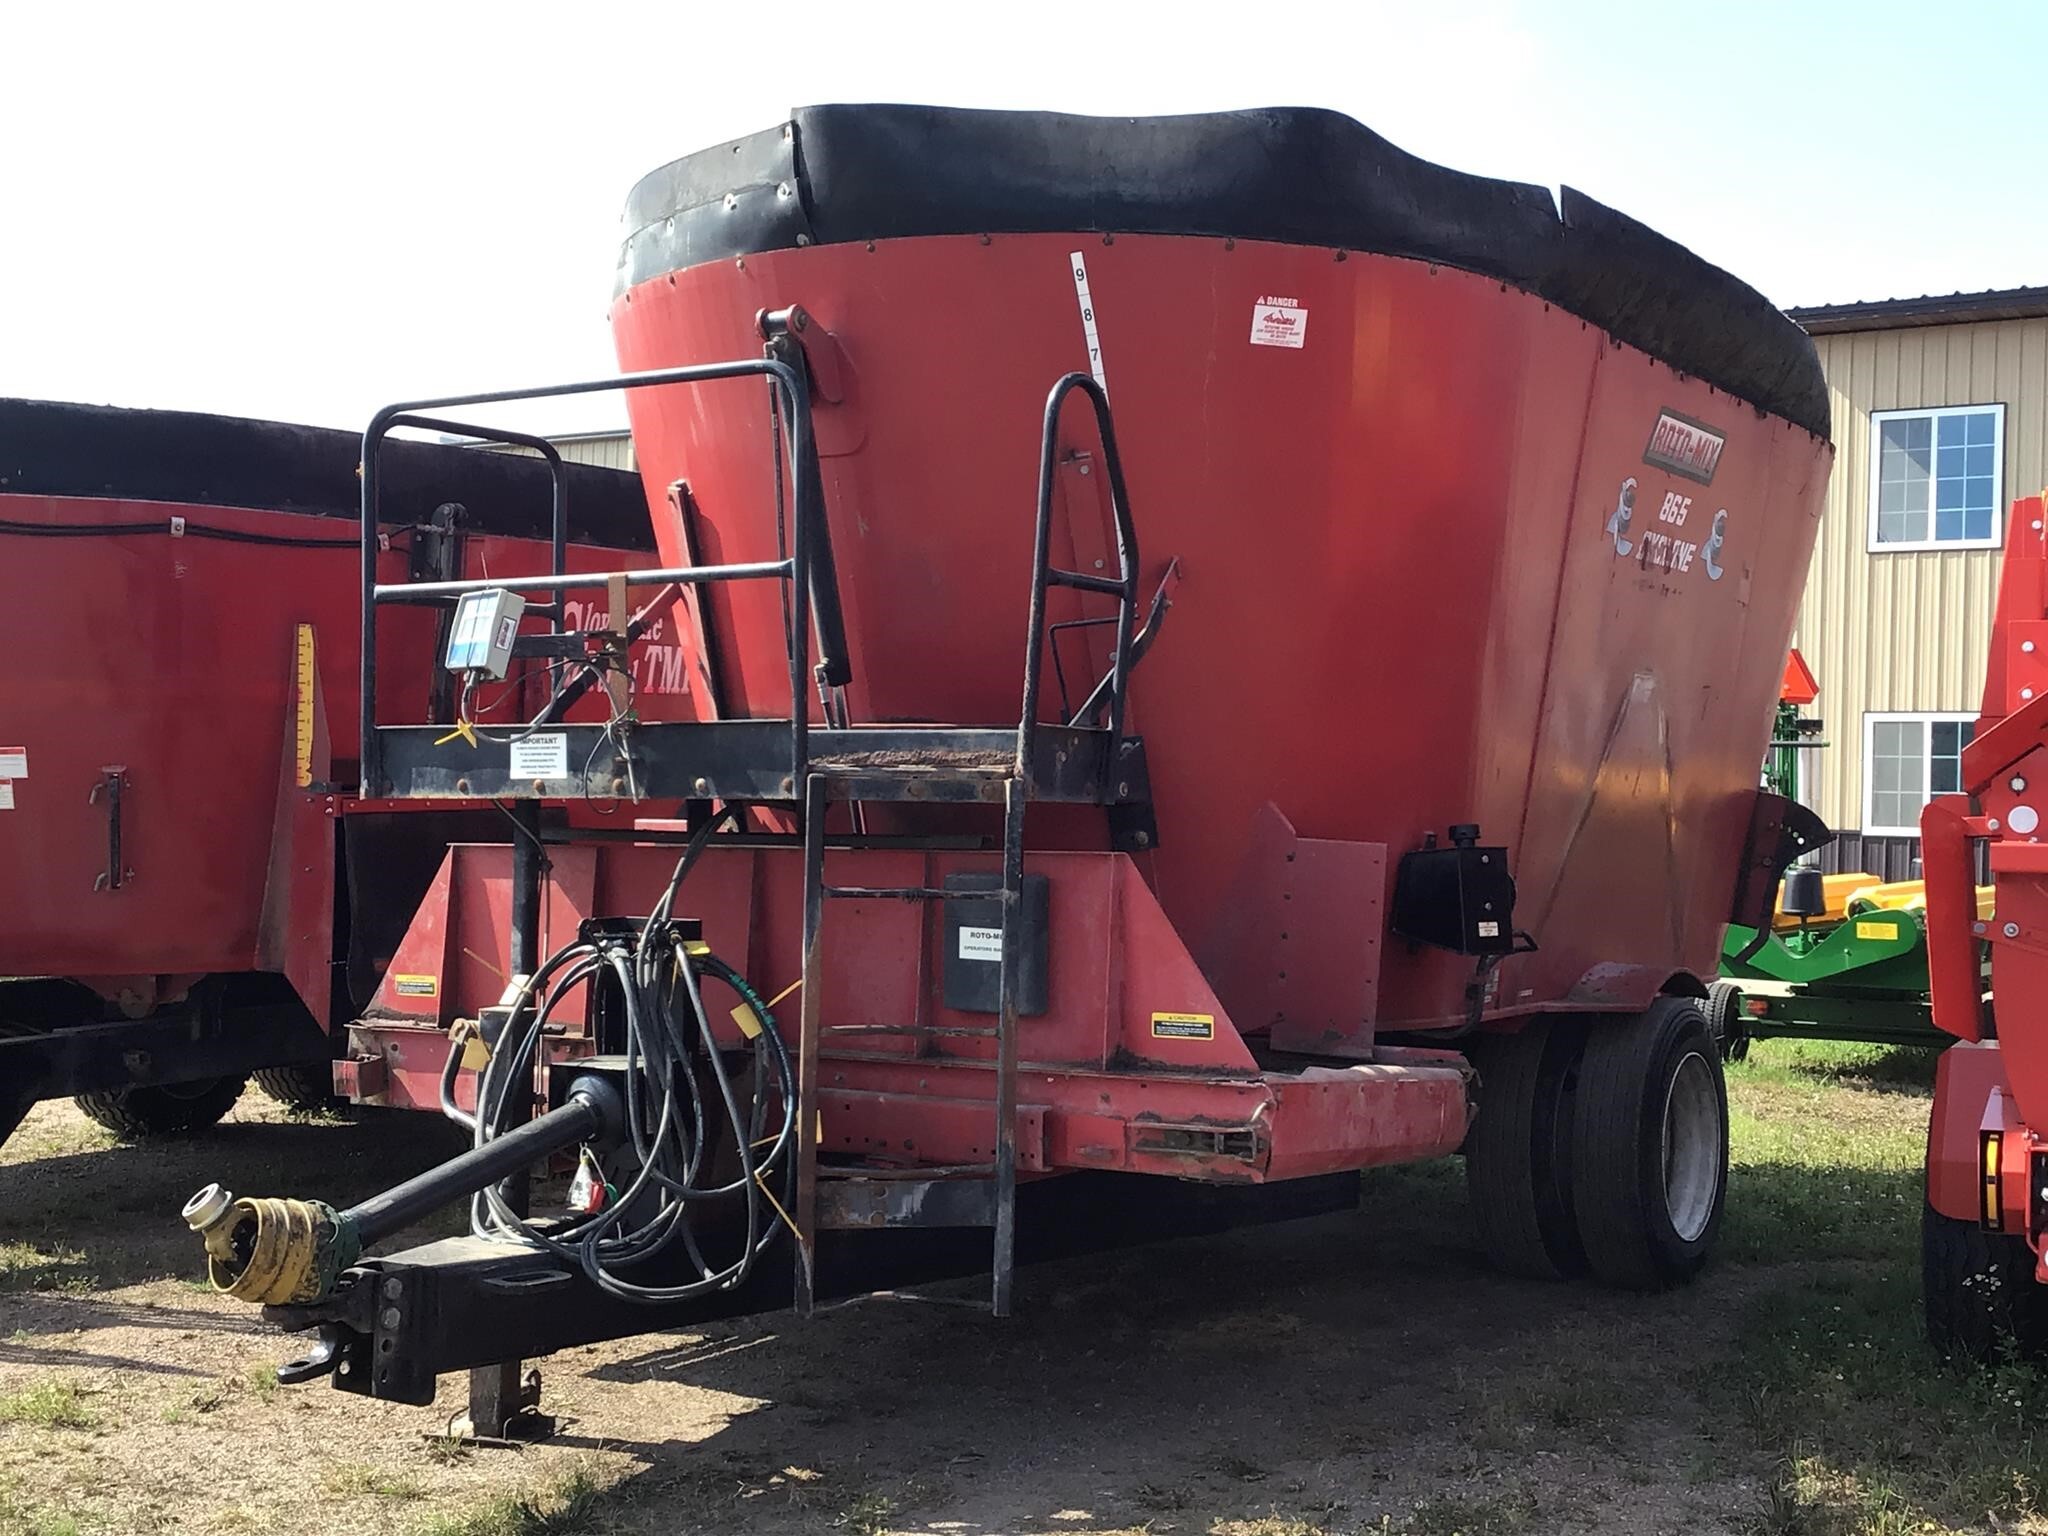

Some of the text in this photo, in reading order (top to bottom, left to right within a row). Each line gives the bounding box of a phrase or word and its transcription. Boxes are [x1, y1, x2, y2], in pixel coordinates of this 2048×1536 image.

[1076, 268, 1084, 281] 9
[1267, 296, 1298, 307] DANGER
[1084, 308, 1092, 321] 8
[1091, 348, 1098, 361] 7
[1659, 491, 1692, 526] 865
[644, 644, 690, 694] TM
[520, 736, 558, 744] IMPORTANT
[970, 931, 1002, 940] ROTO-M
